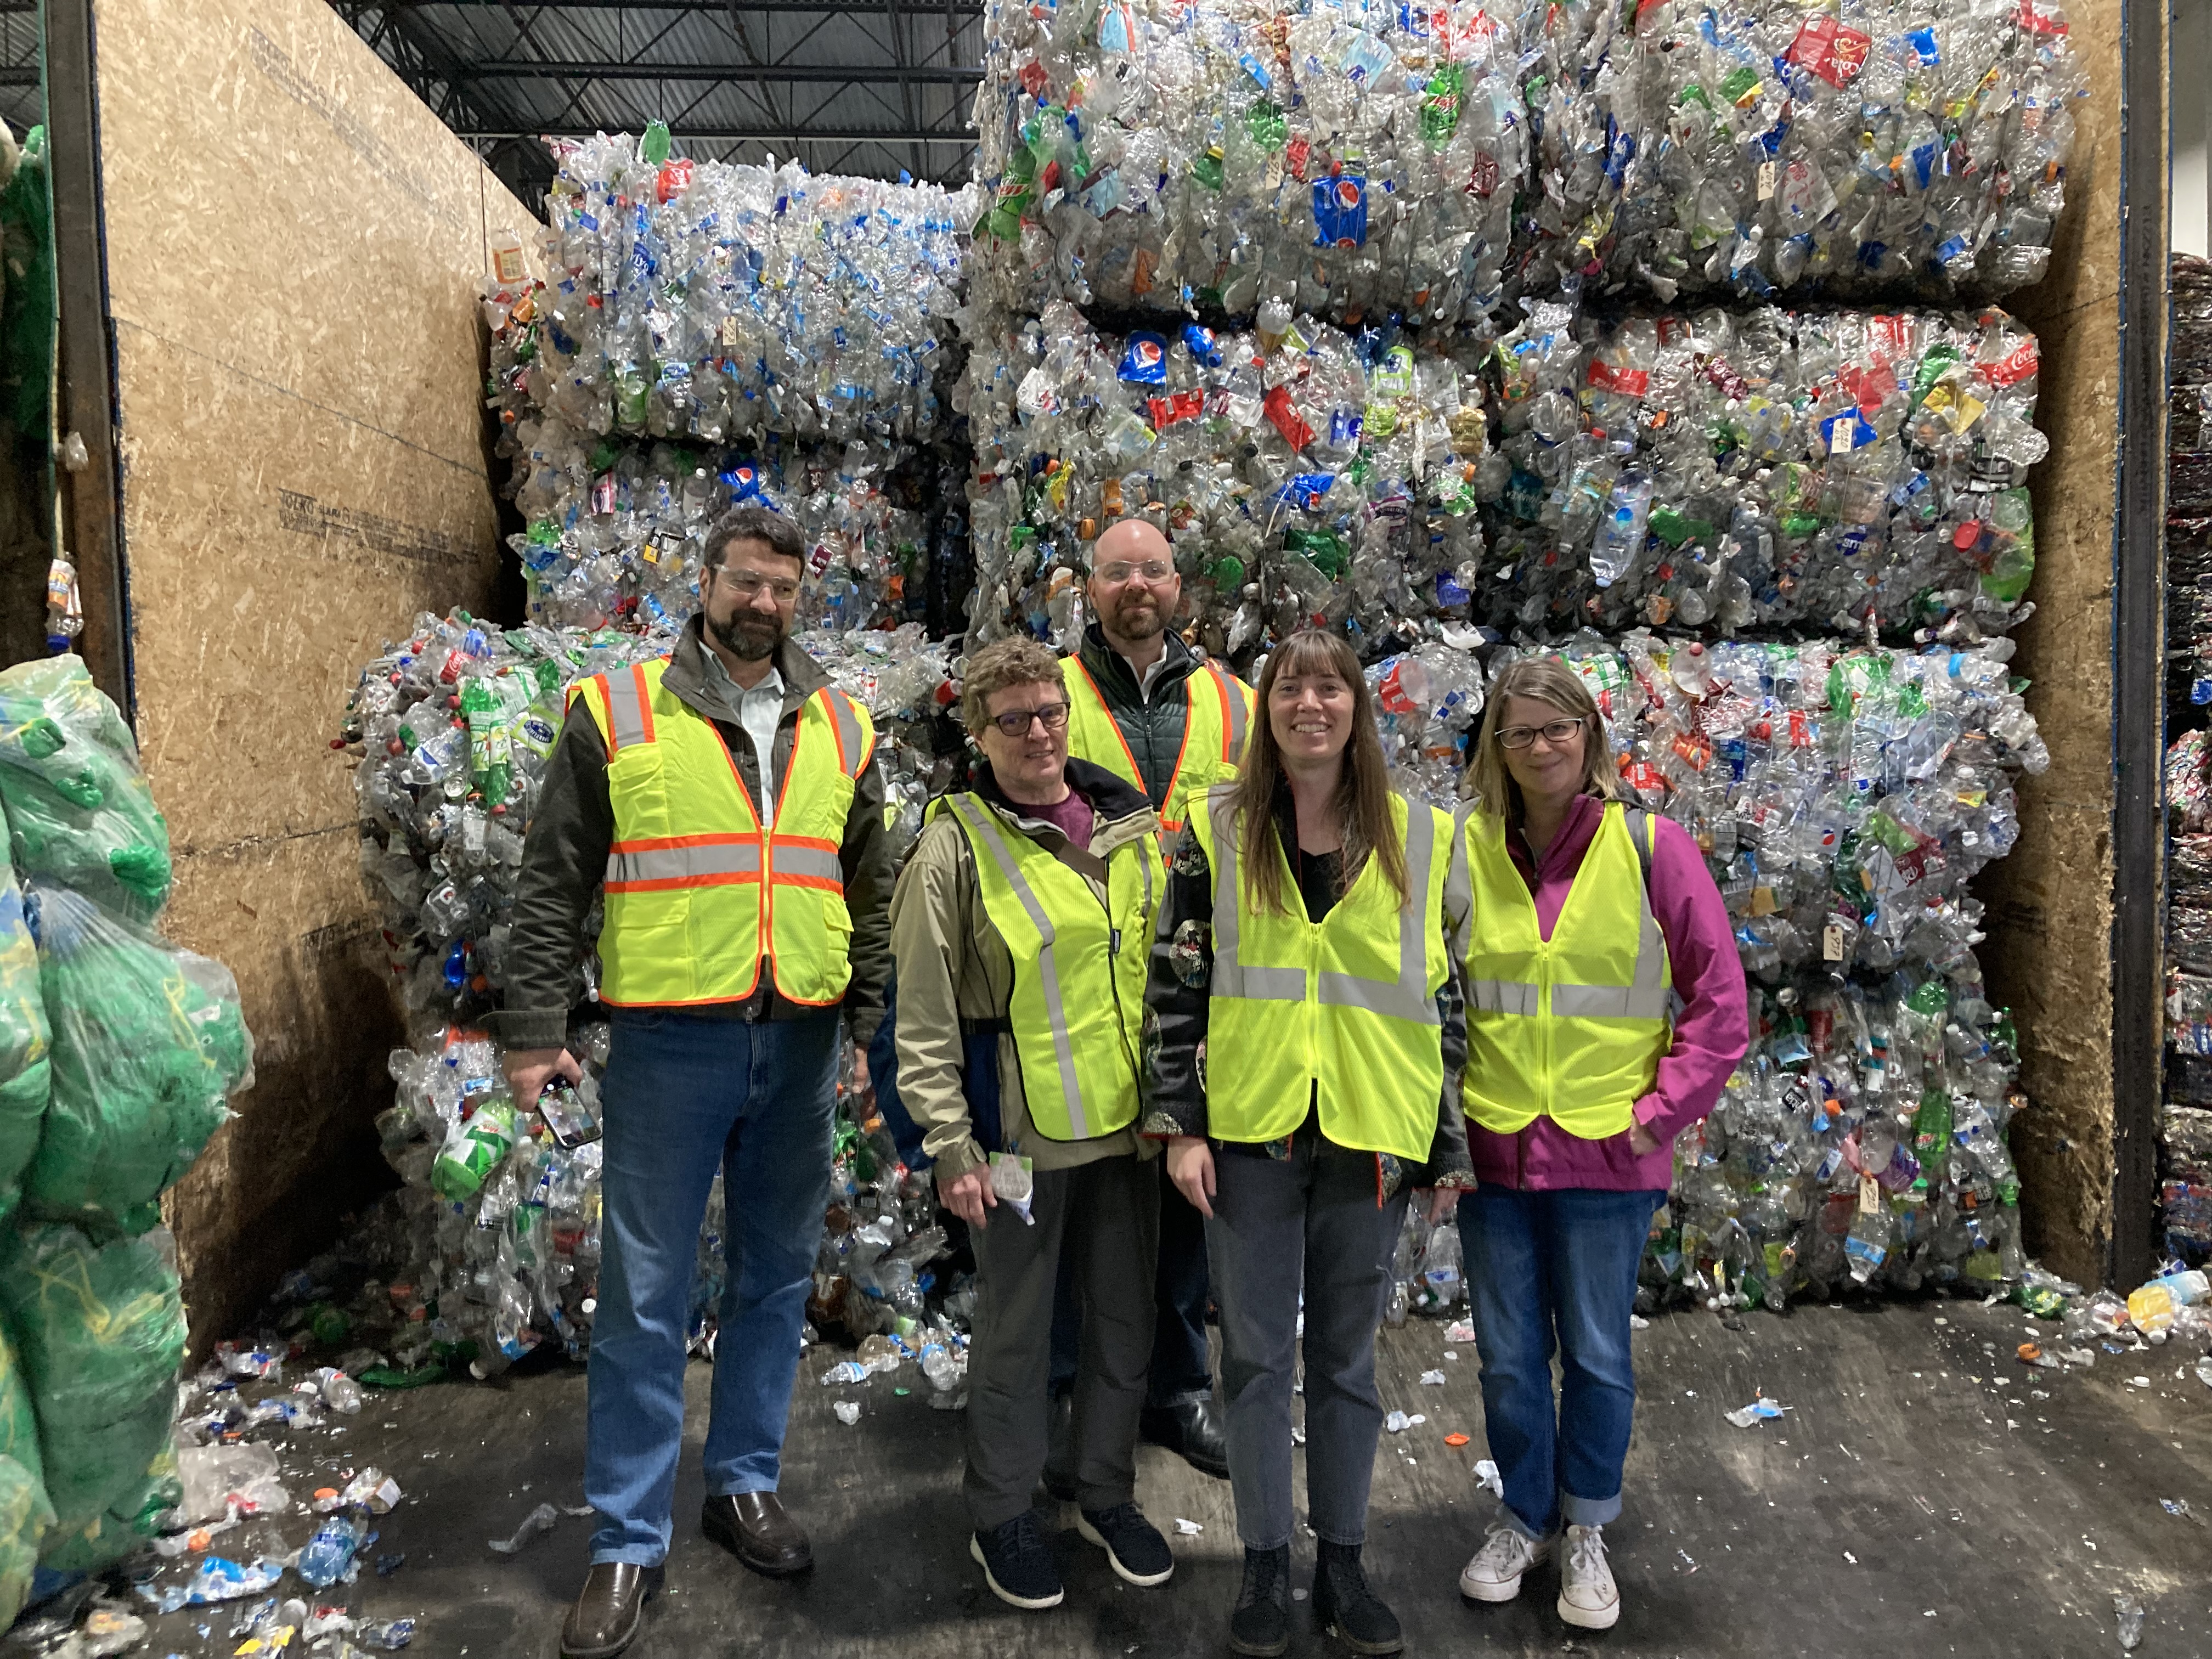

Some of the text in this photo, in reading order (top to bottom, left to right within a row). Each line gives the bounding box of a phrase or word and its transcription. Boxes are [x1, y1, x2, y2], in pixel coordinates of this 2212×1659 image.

[1323, 184, 1331, 209] pepsi
[727, 324, 736, 343] 958
[1842, 537, 1878, 553] smart
